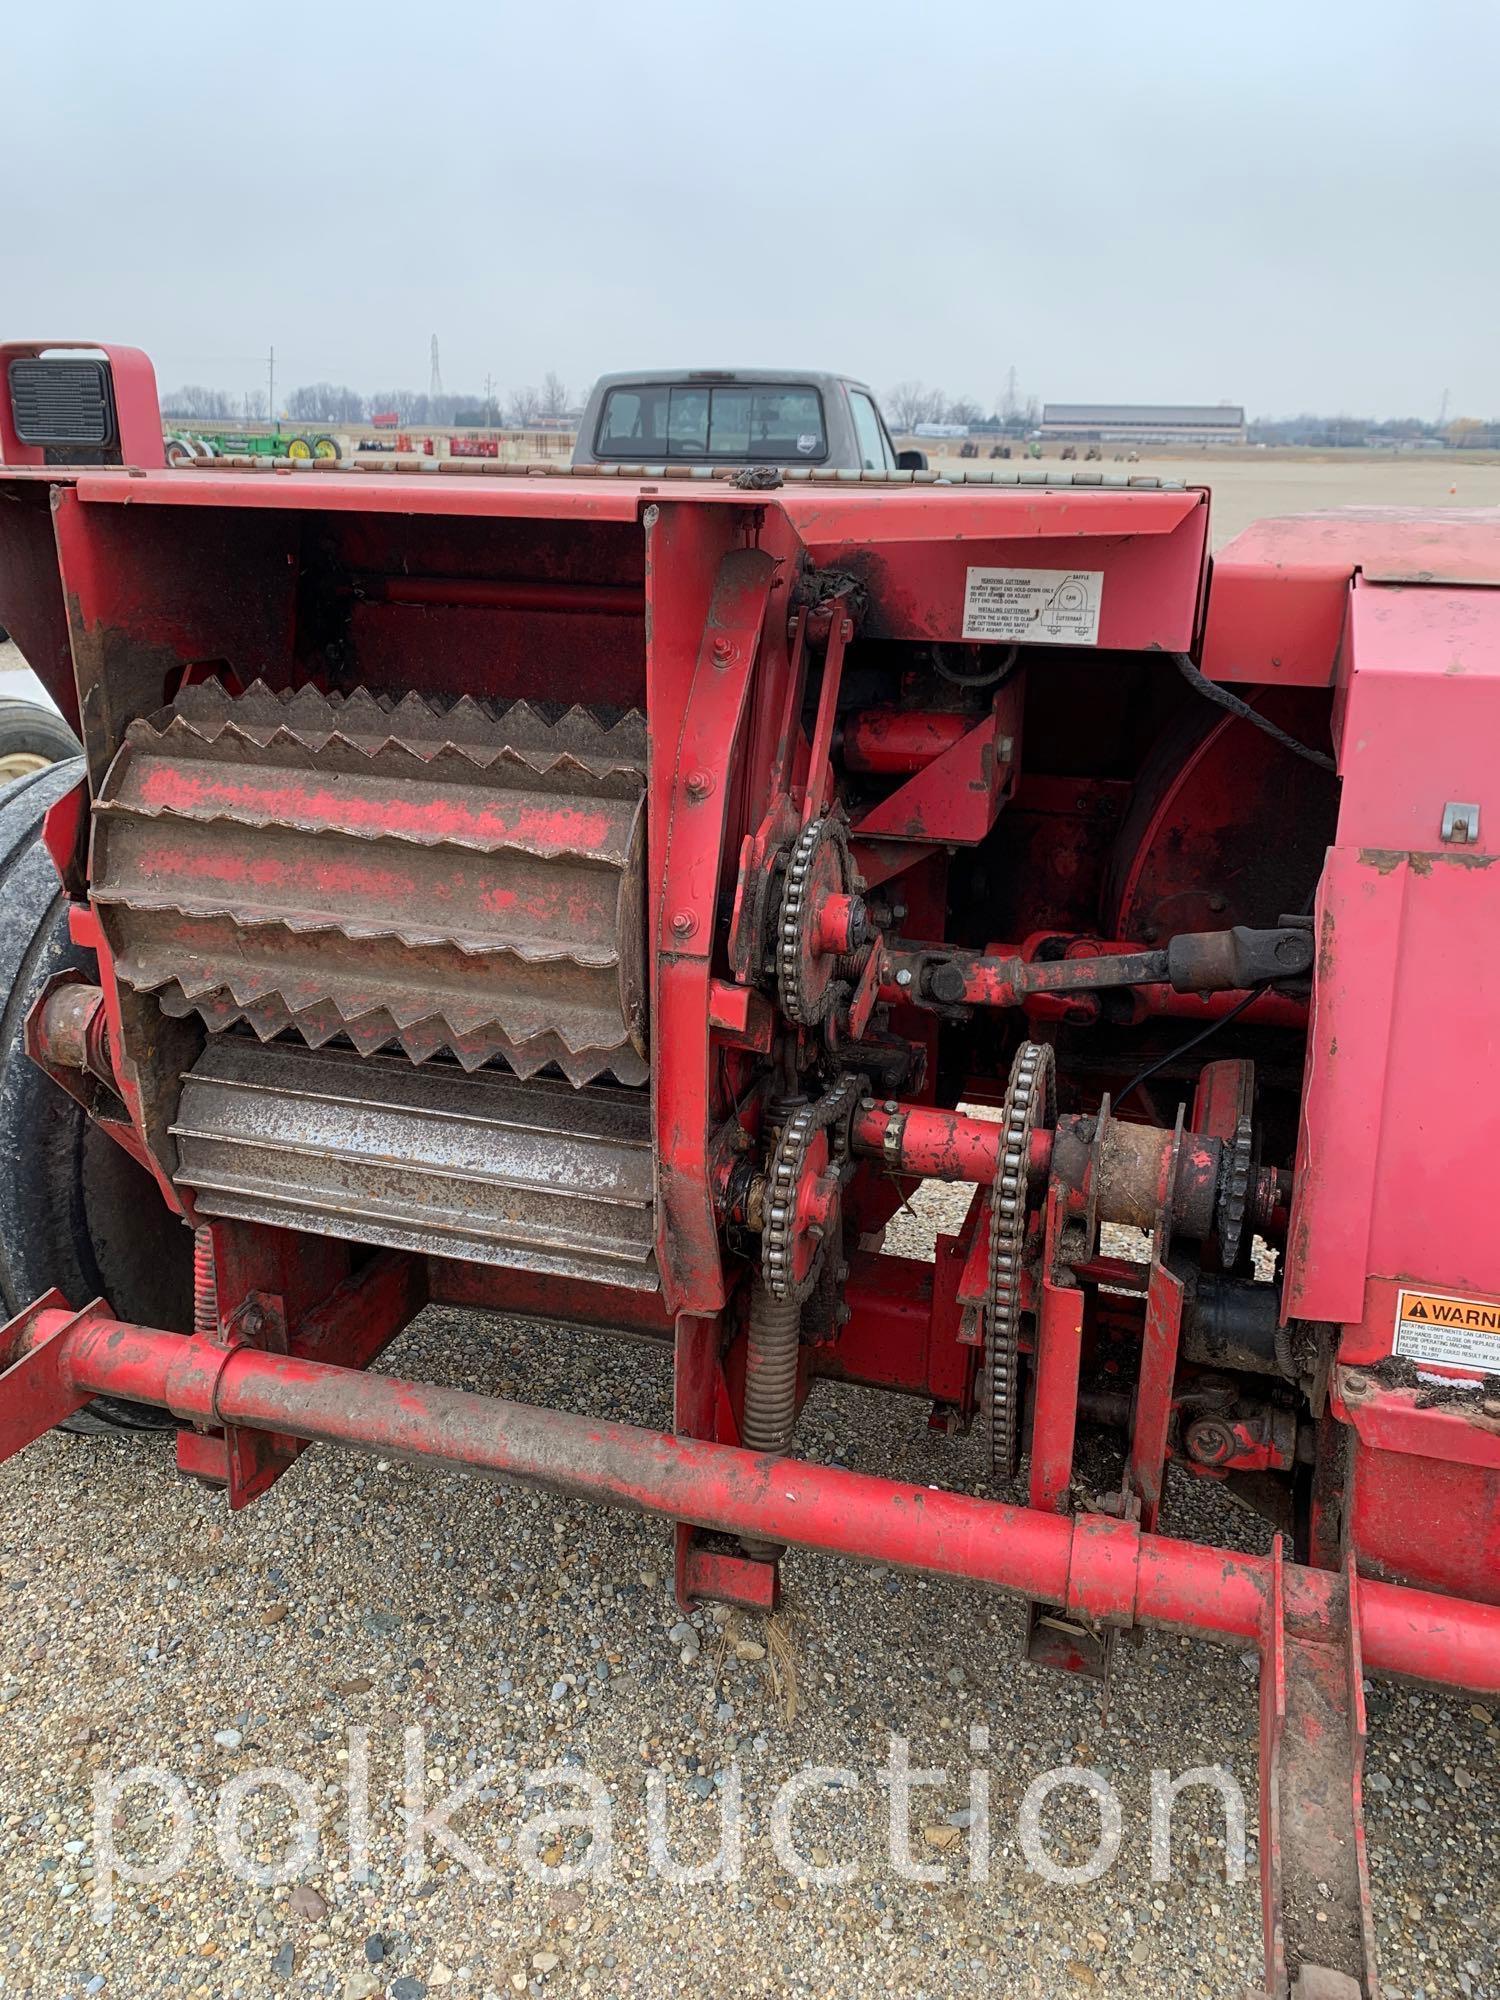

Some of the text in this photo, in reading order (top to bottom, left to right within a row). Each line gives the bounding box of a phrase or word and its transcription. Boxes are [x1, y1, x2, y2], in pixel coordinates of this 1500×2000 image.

[1432, 1305, 1500, 1328] WARNI
[1402, 1322, 1426, 1330] ROTATING
[1427, 1324, 1462, 1335] COMPONENTS
[1420, 1338, 1448, 1347] OPERATING
[1472, 1340, 1495, 1348] REPLACE
[1462, 1350, 1481, 1358] RESULT
